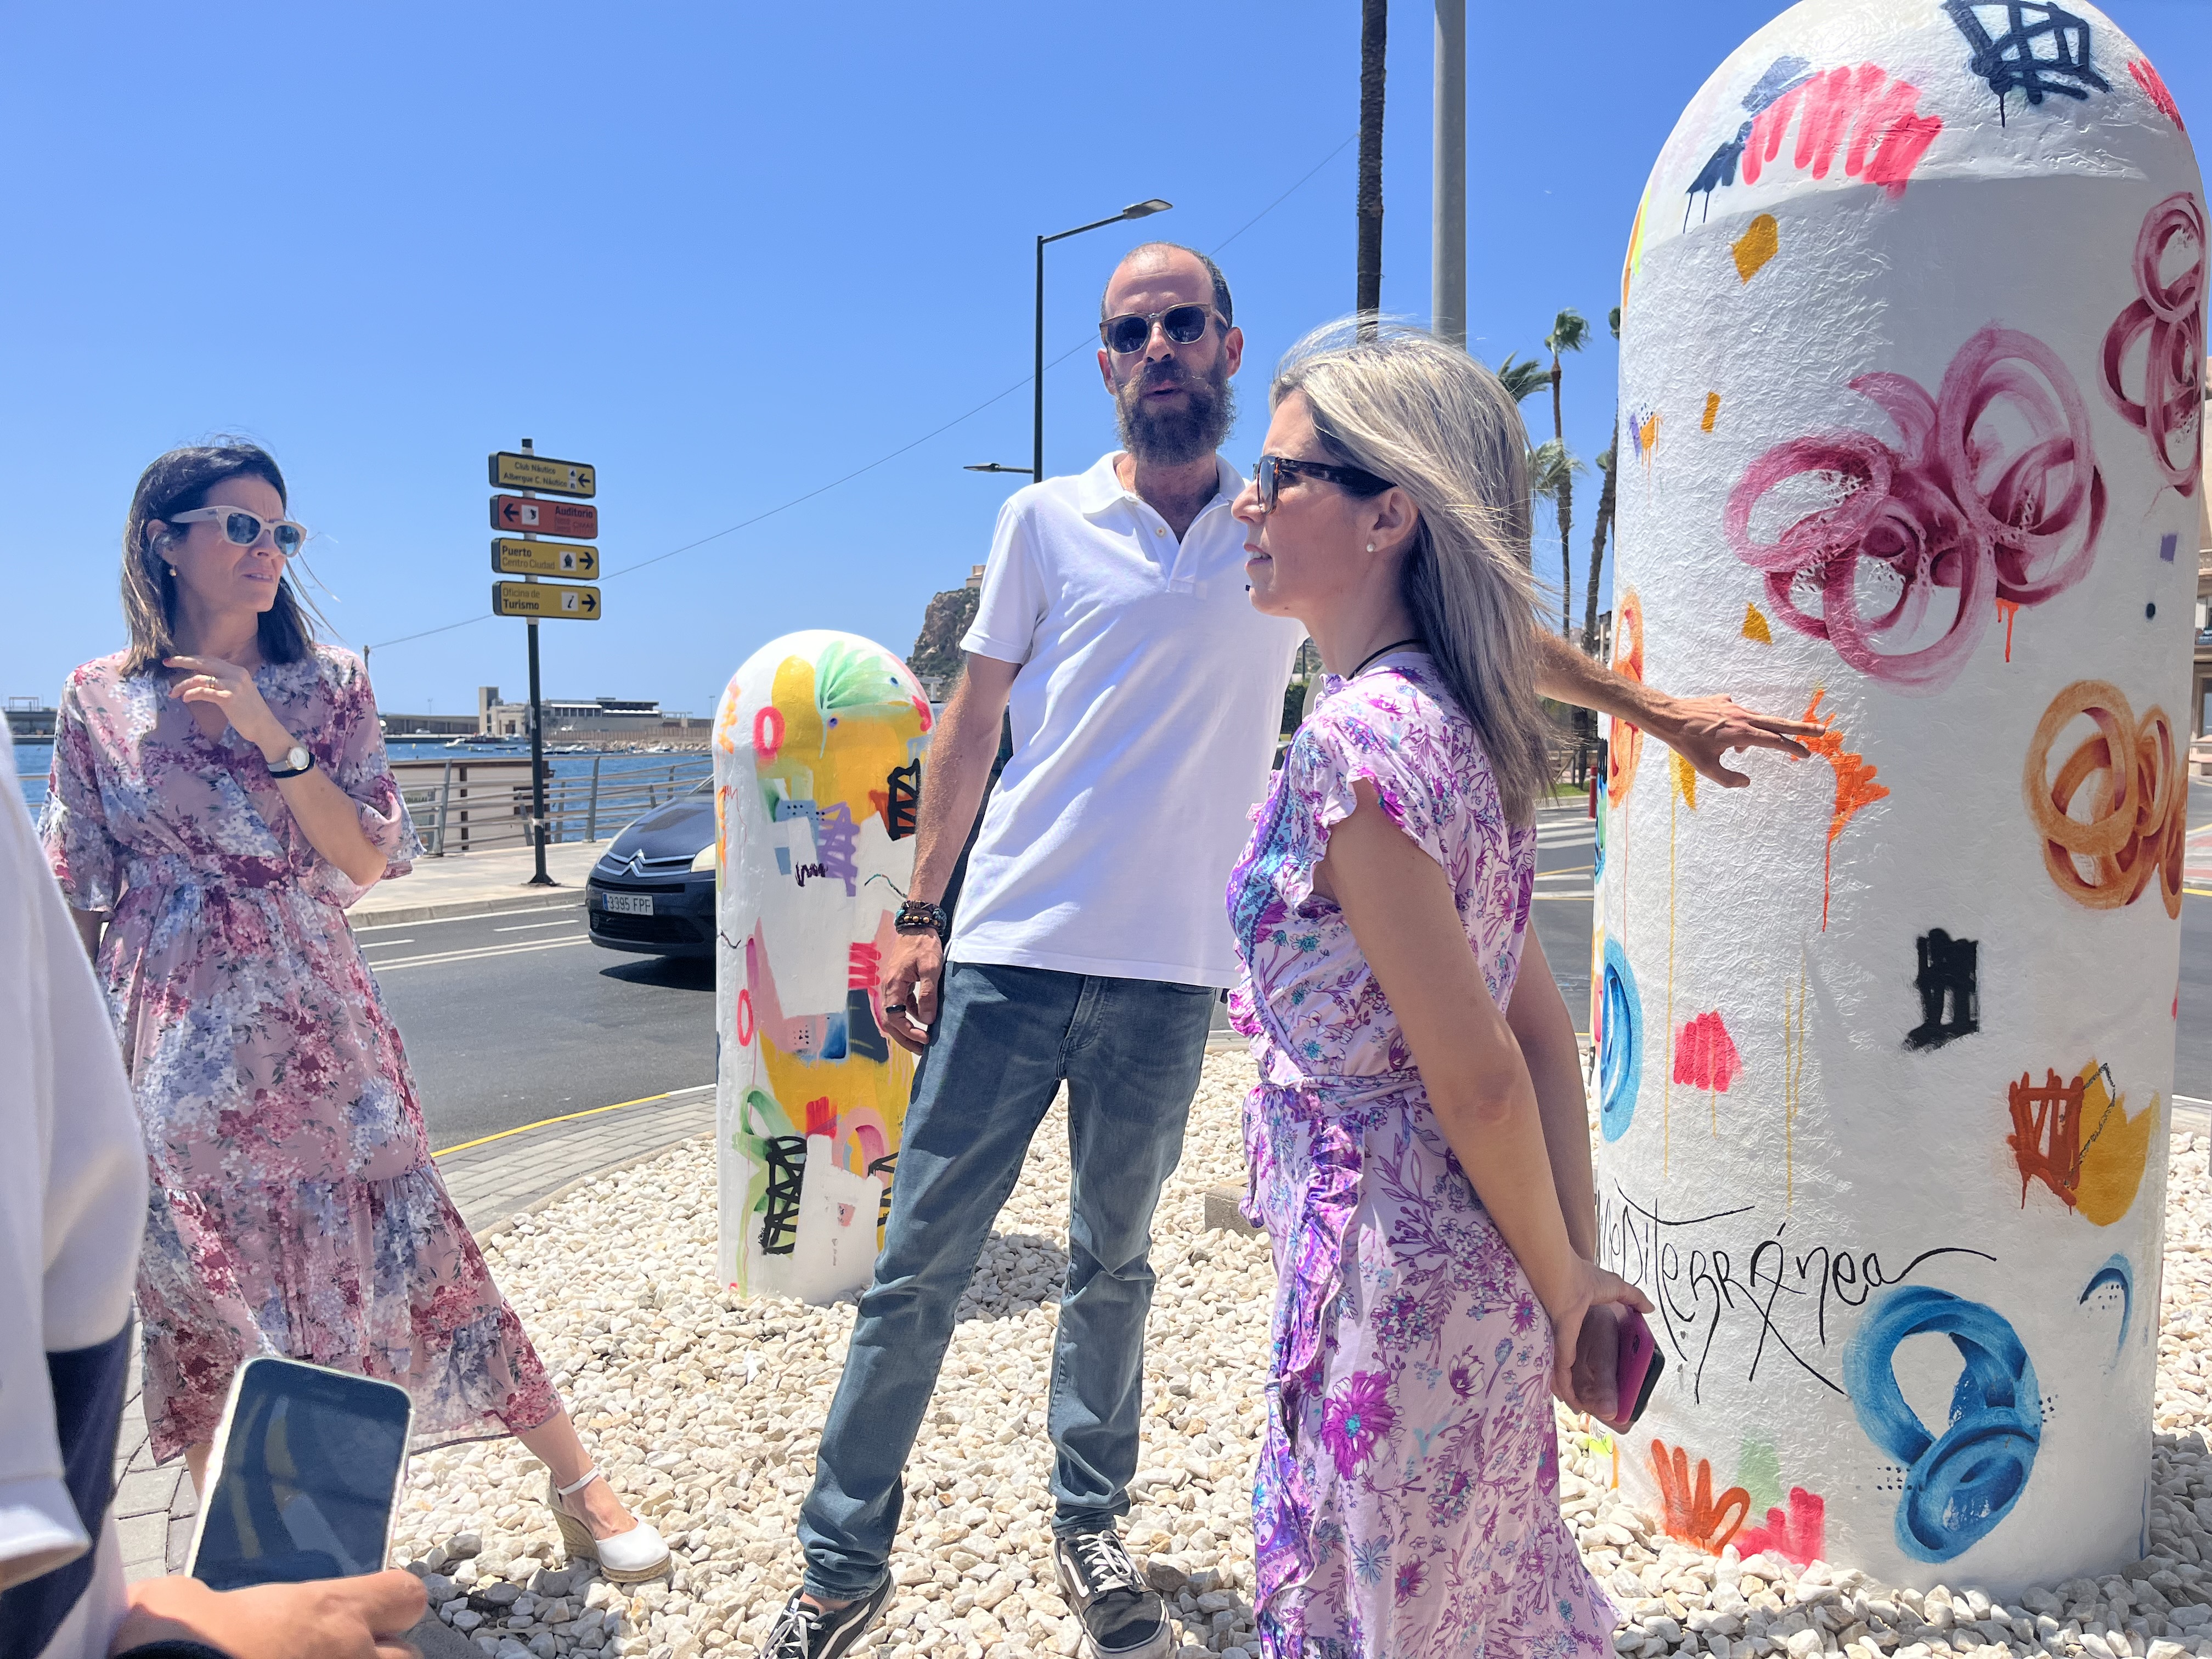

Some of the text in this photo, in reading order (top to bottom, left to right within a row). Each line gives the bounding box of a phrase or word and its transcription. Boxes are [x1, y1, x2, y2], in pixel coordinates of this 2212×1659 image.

[515, 461, 530, 471] Club
[504, 472, 533, 484] Albergue
[555, 506, 593, 518] Auditorio
[502, 545, 532, 557] Puerto
[502, 556, 555, 569] Centro Ciudad
[503, 587, 540, 598] Oficina de
[503, 599, 539, 610] Turismo
[609, 896, 651, 913] 3395 FPF
